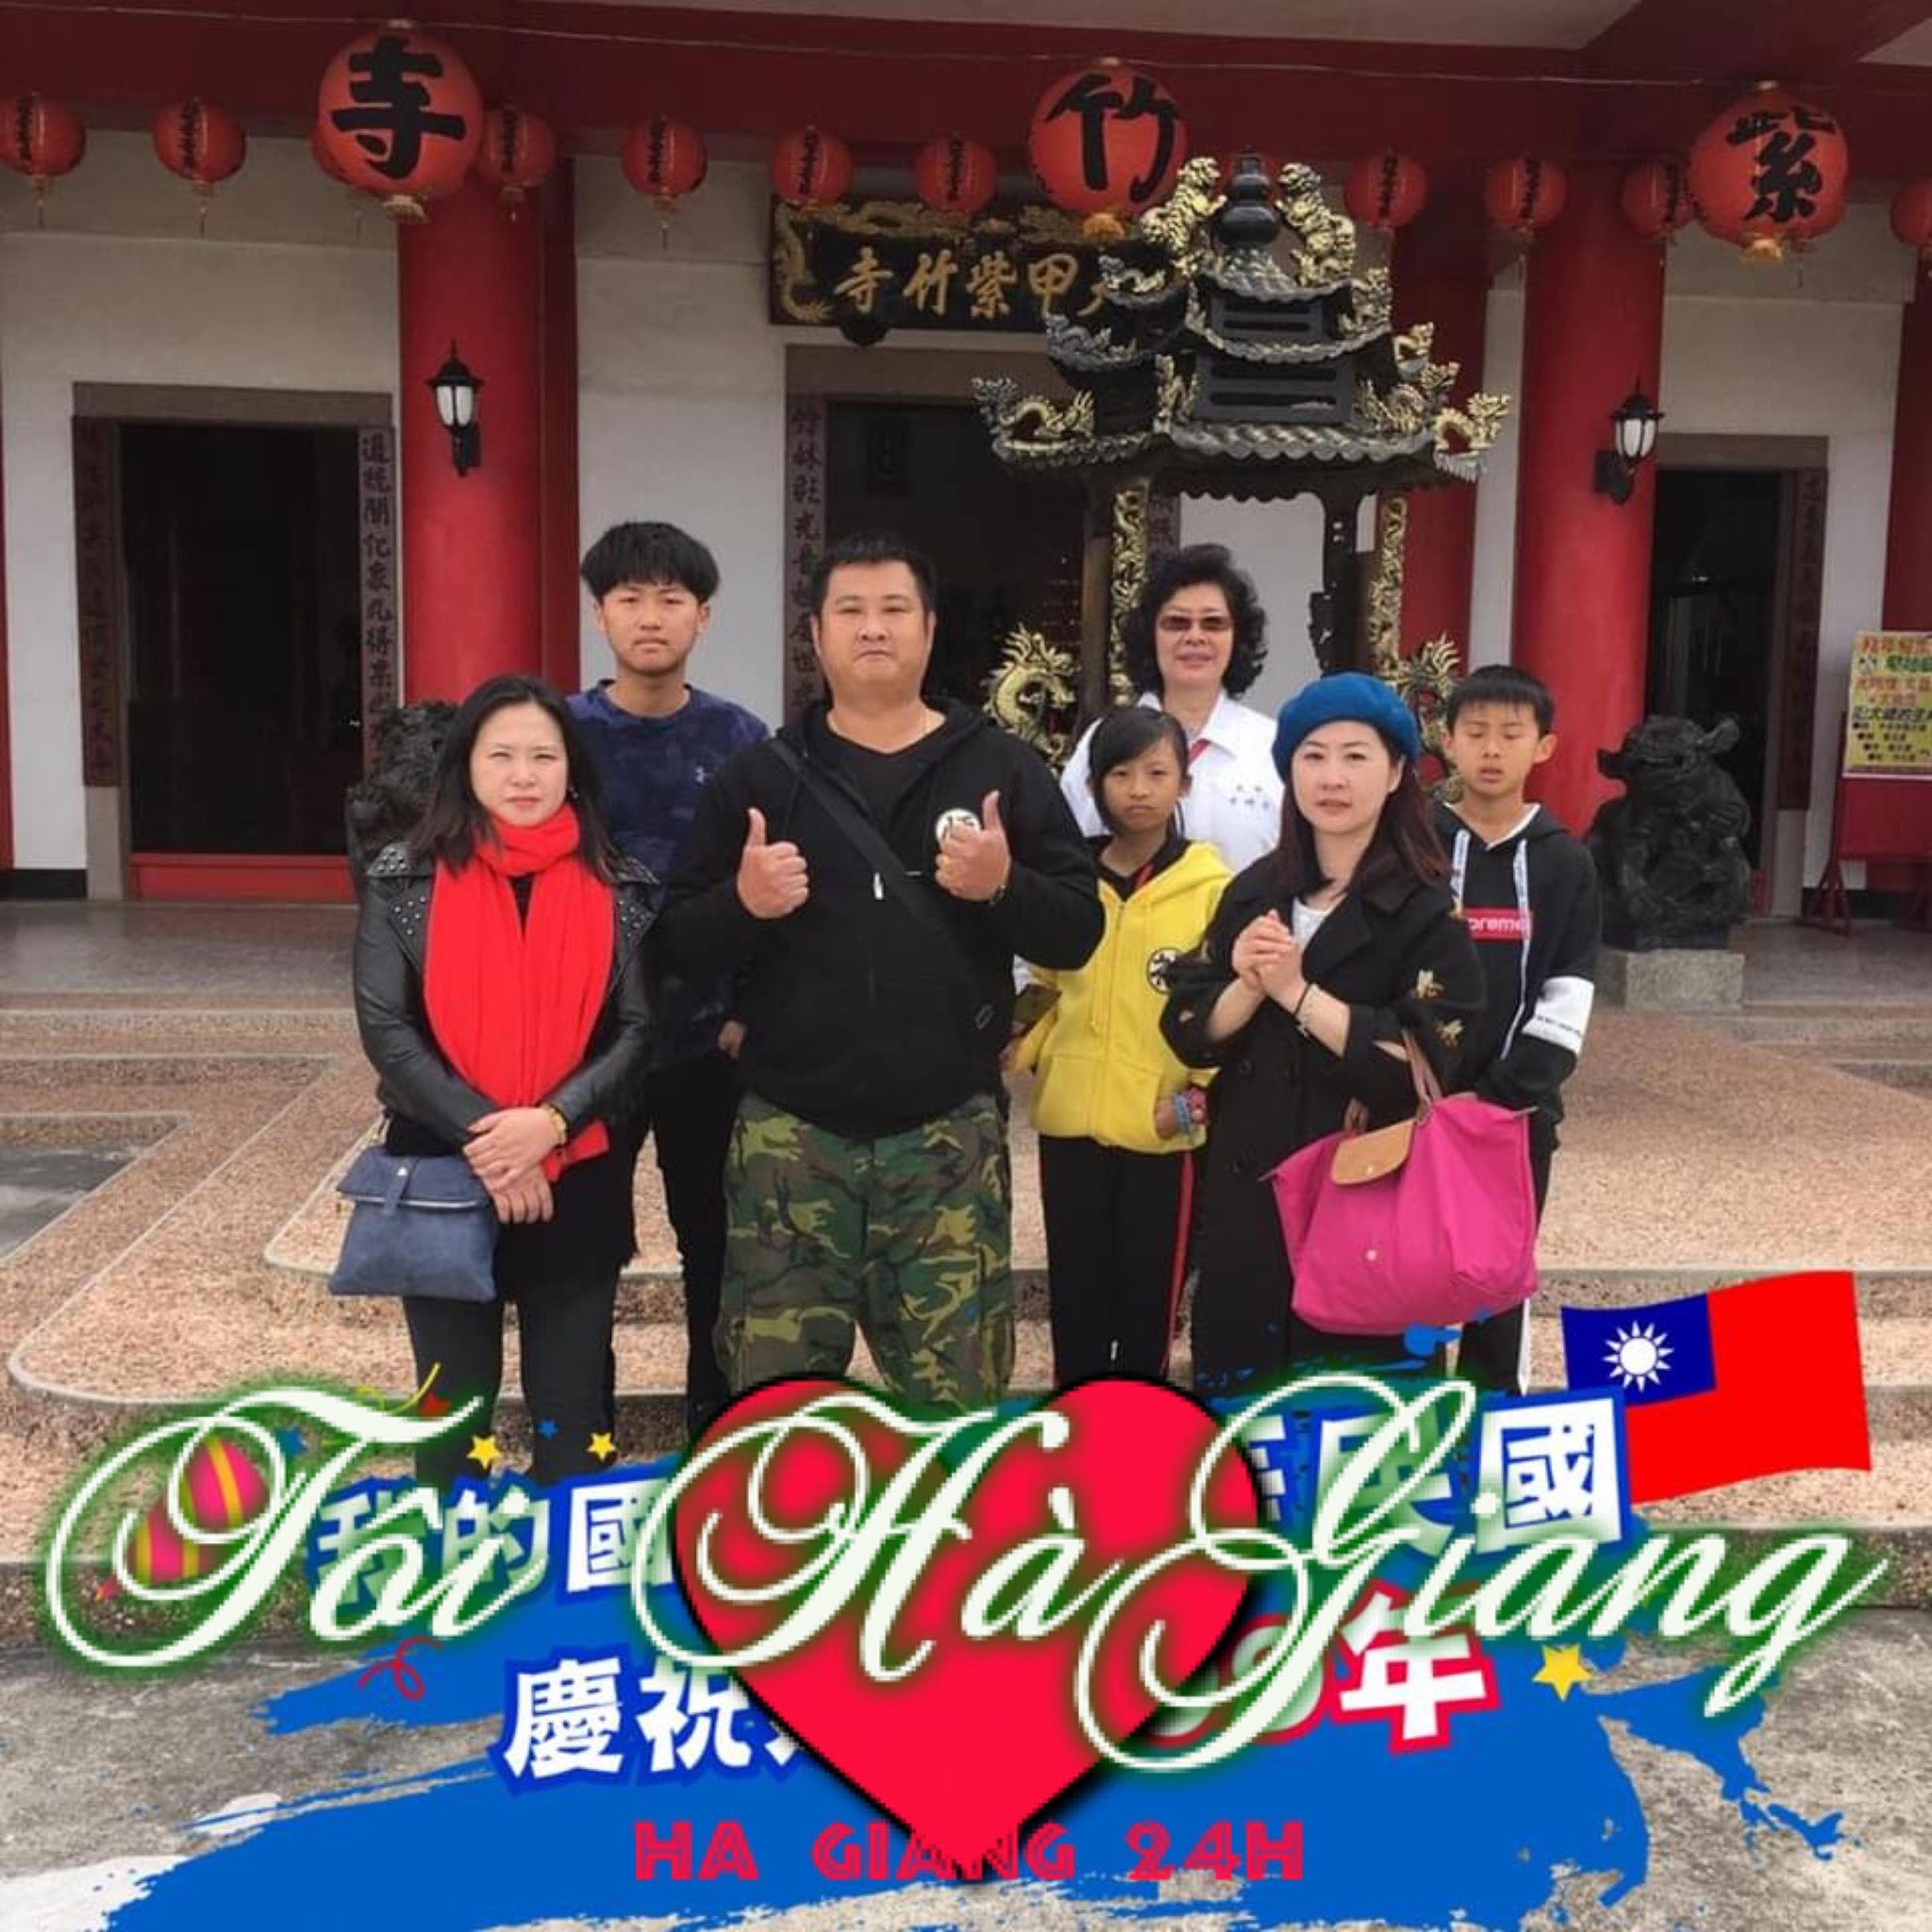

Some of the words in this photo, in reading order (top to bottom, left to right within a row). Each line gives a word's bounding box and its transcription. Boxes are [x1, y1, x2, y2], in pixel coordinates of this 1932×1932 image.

[331, 36, 466, 179] 寺
[1043, 73, 1177, 203] 竹
[1725, 106, 1836, 224] 紫
